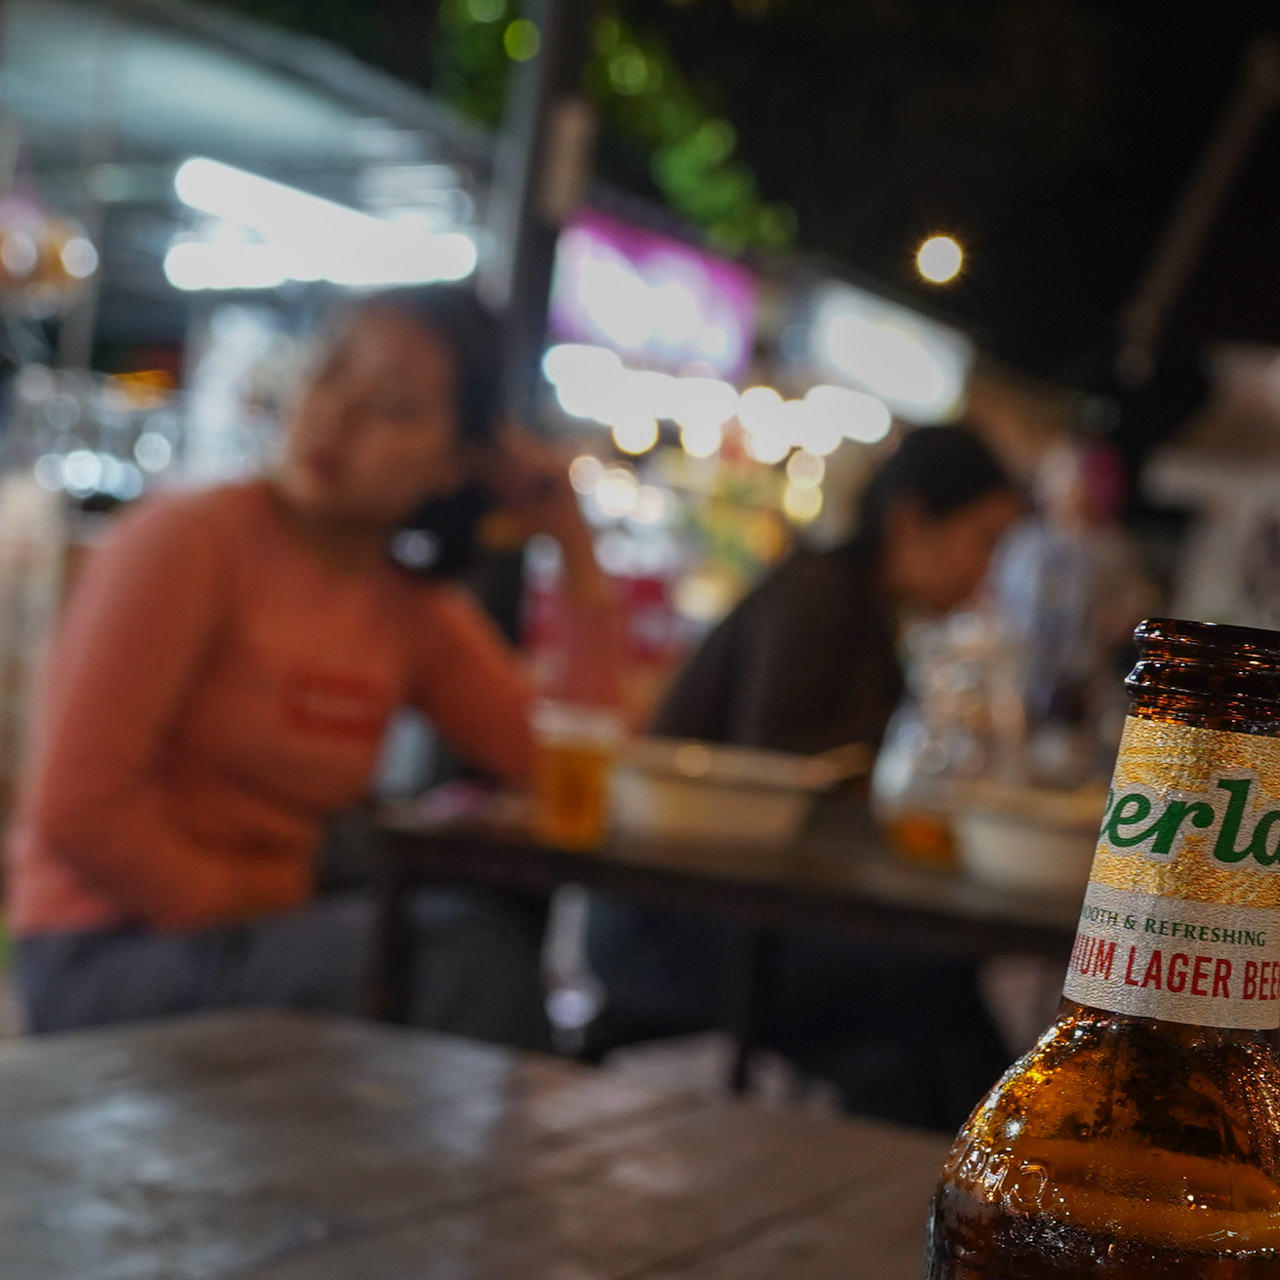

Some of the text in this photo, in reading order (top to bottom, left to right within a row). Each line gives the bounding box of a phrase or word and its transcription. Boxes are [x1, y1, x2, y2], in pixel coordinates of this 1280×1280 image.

[1082, 905, 1268, 947] OOTH & REFRESHING
[1124, 945, 1232, 999] LAGER
